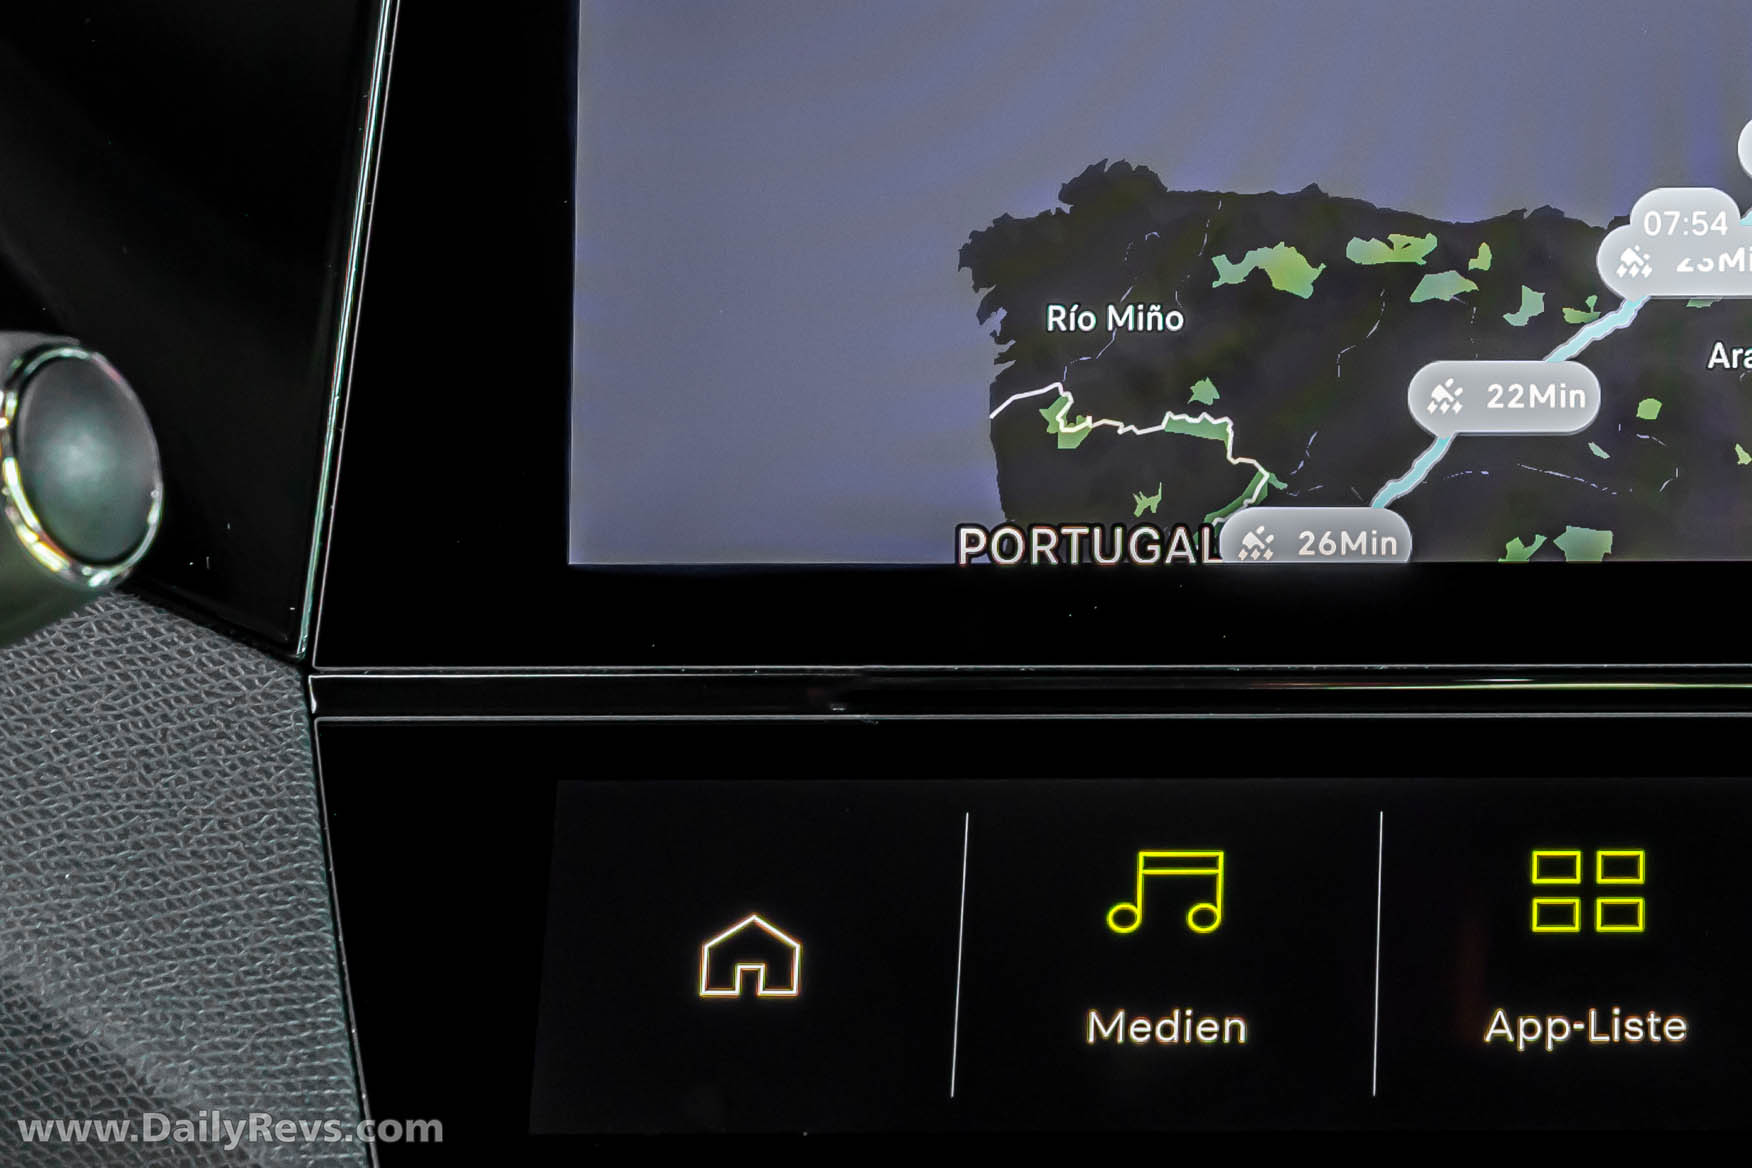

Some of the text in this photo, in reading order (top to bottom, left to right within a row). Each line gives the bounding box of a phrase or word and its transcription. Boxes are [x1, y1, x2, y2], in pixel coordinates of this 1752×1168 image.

[1643, 210, 1729, 237] 07:54
[1046, 304, 1185, 333] Río Miño
[1486, 383, 1587, 410] 22Min
[958, 526, 1224, 564] PORTUGAL
[1297, 530, 1398, 556] 26Min
[1086, 1008, 1248, 1044] Medien
[1484, 1008, 1689, 1051] App-Liste
